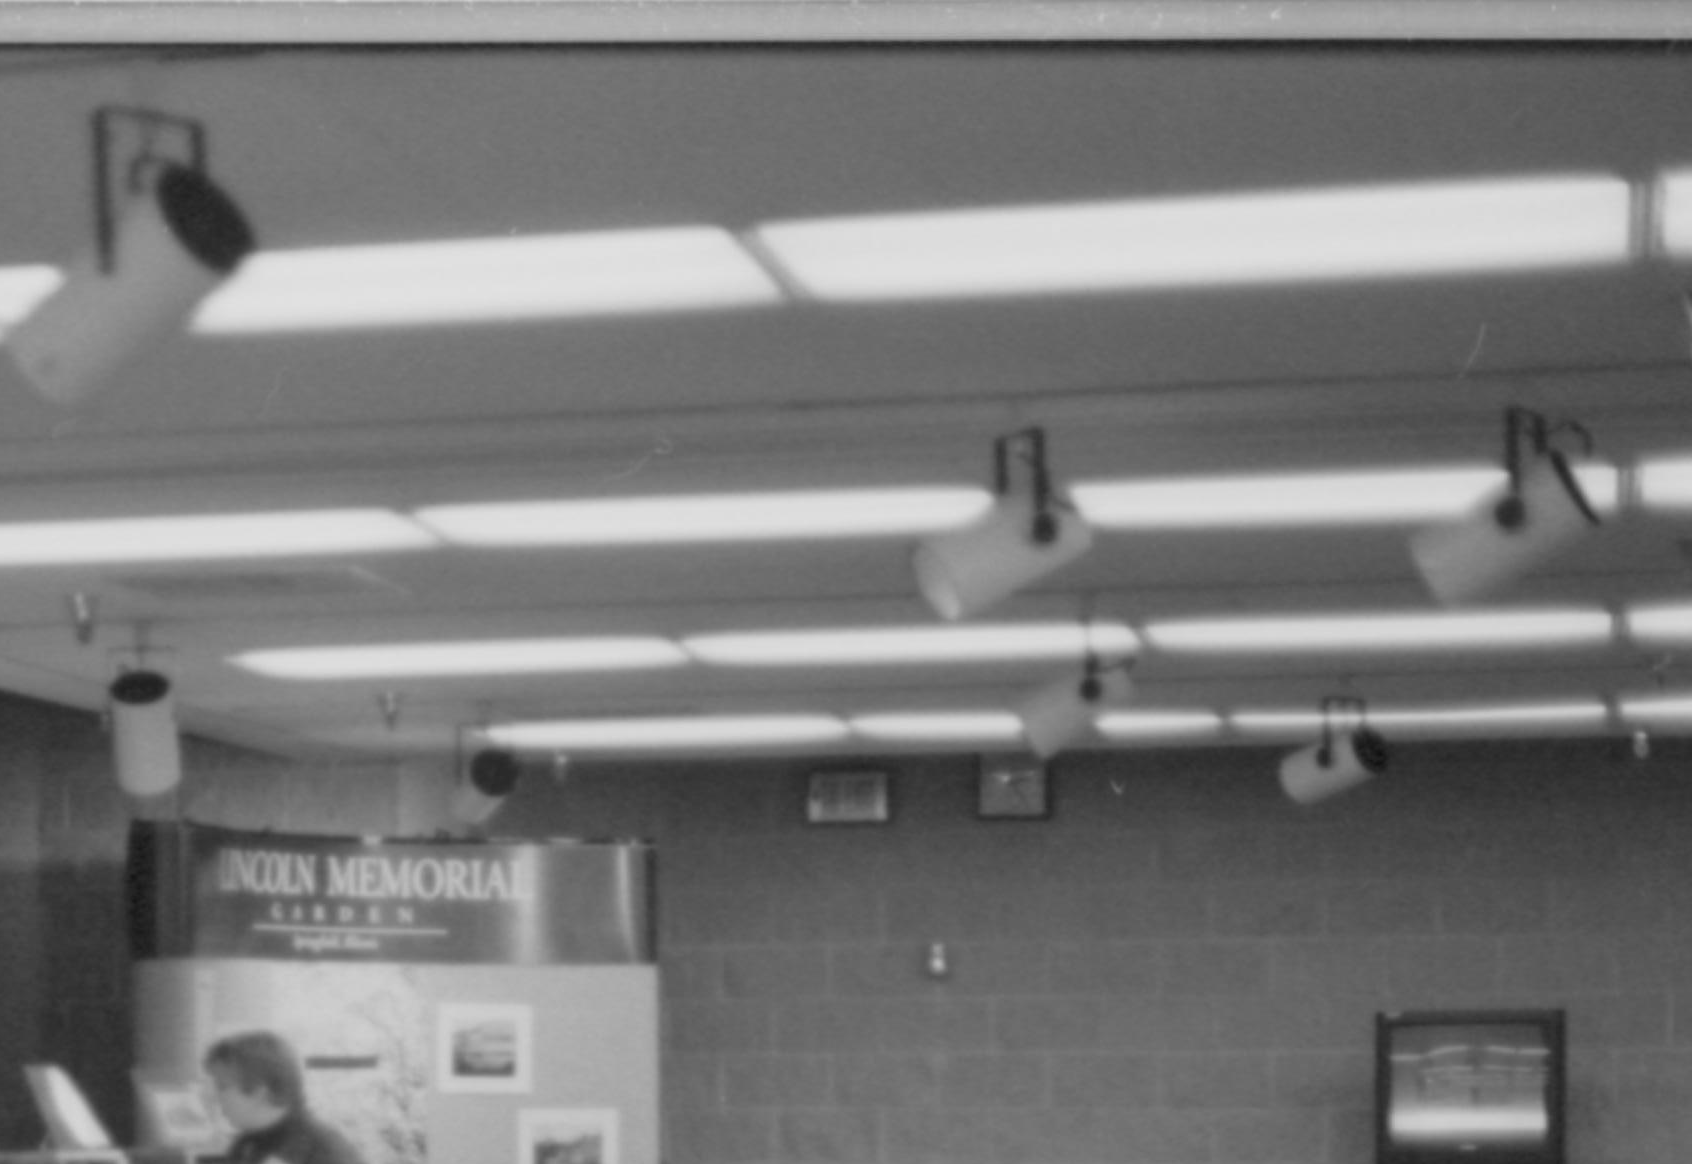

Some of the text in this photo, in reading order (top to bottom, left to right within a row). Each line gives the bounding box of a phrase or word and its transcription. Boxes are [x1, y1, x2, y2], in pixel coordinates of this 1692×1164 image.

[218, 847, 528, 900] LINCOLN MEMORIAL
[269, 901, 415, 925] GARDEN
